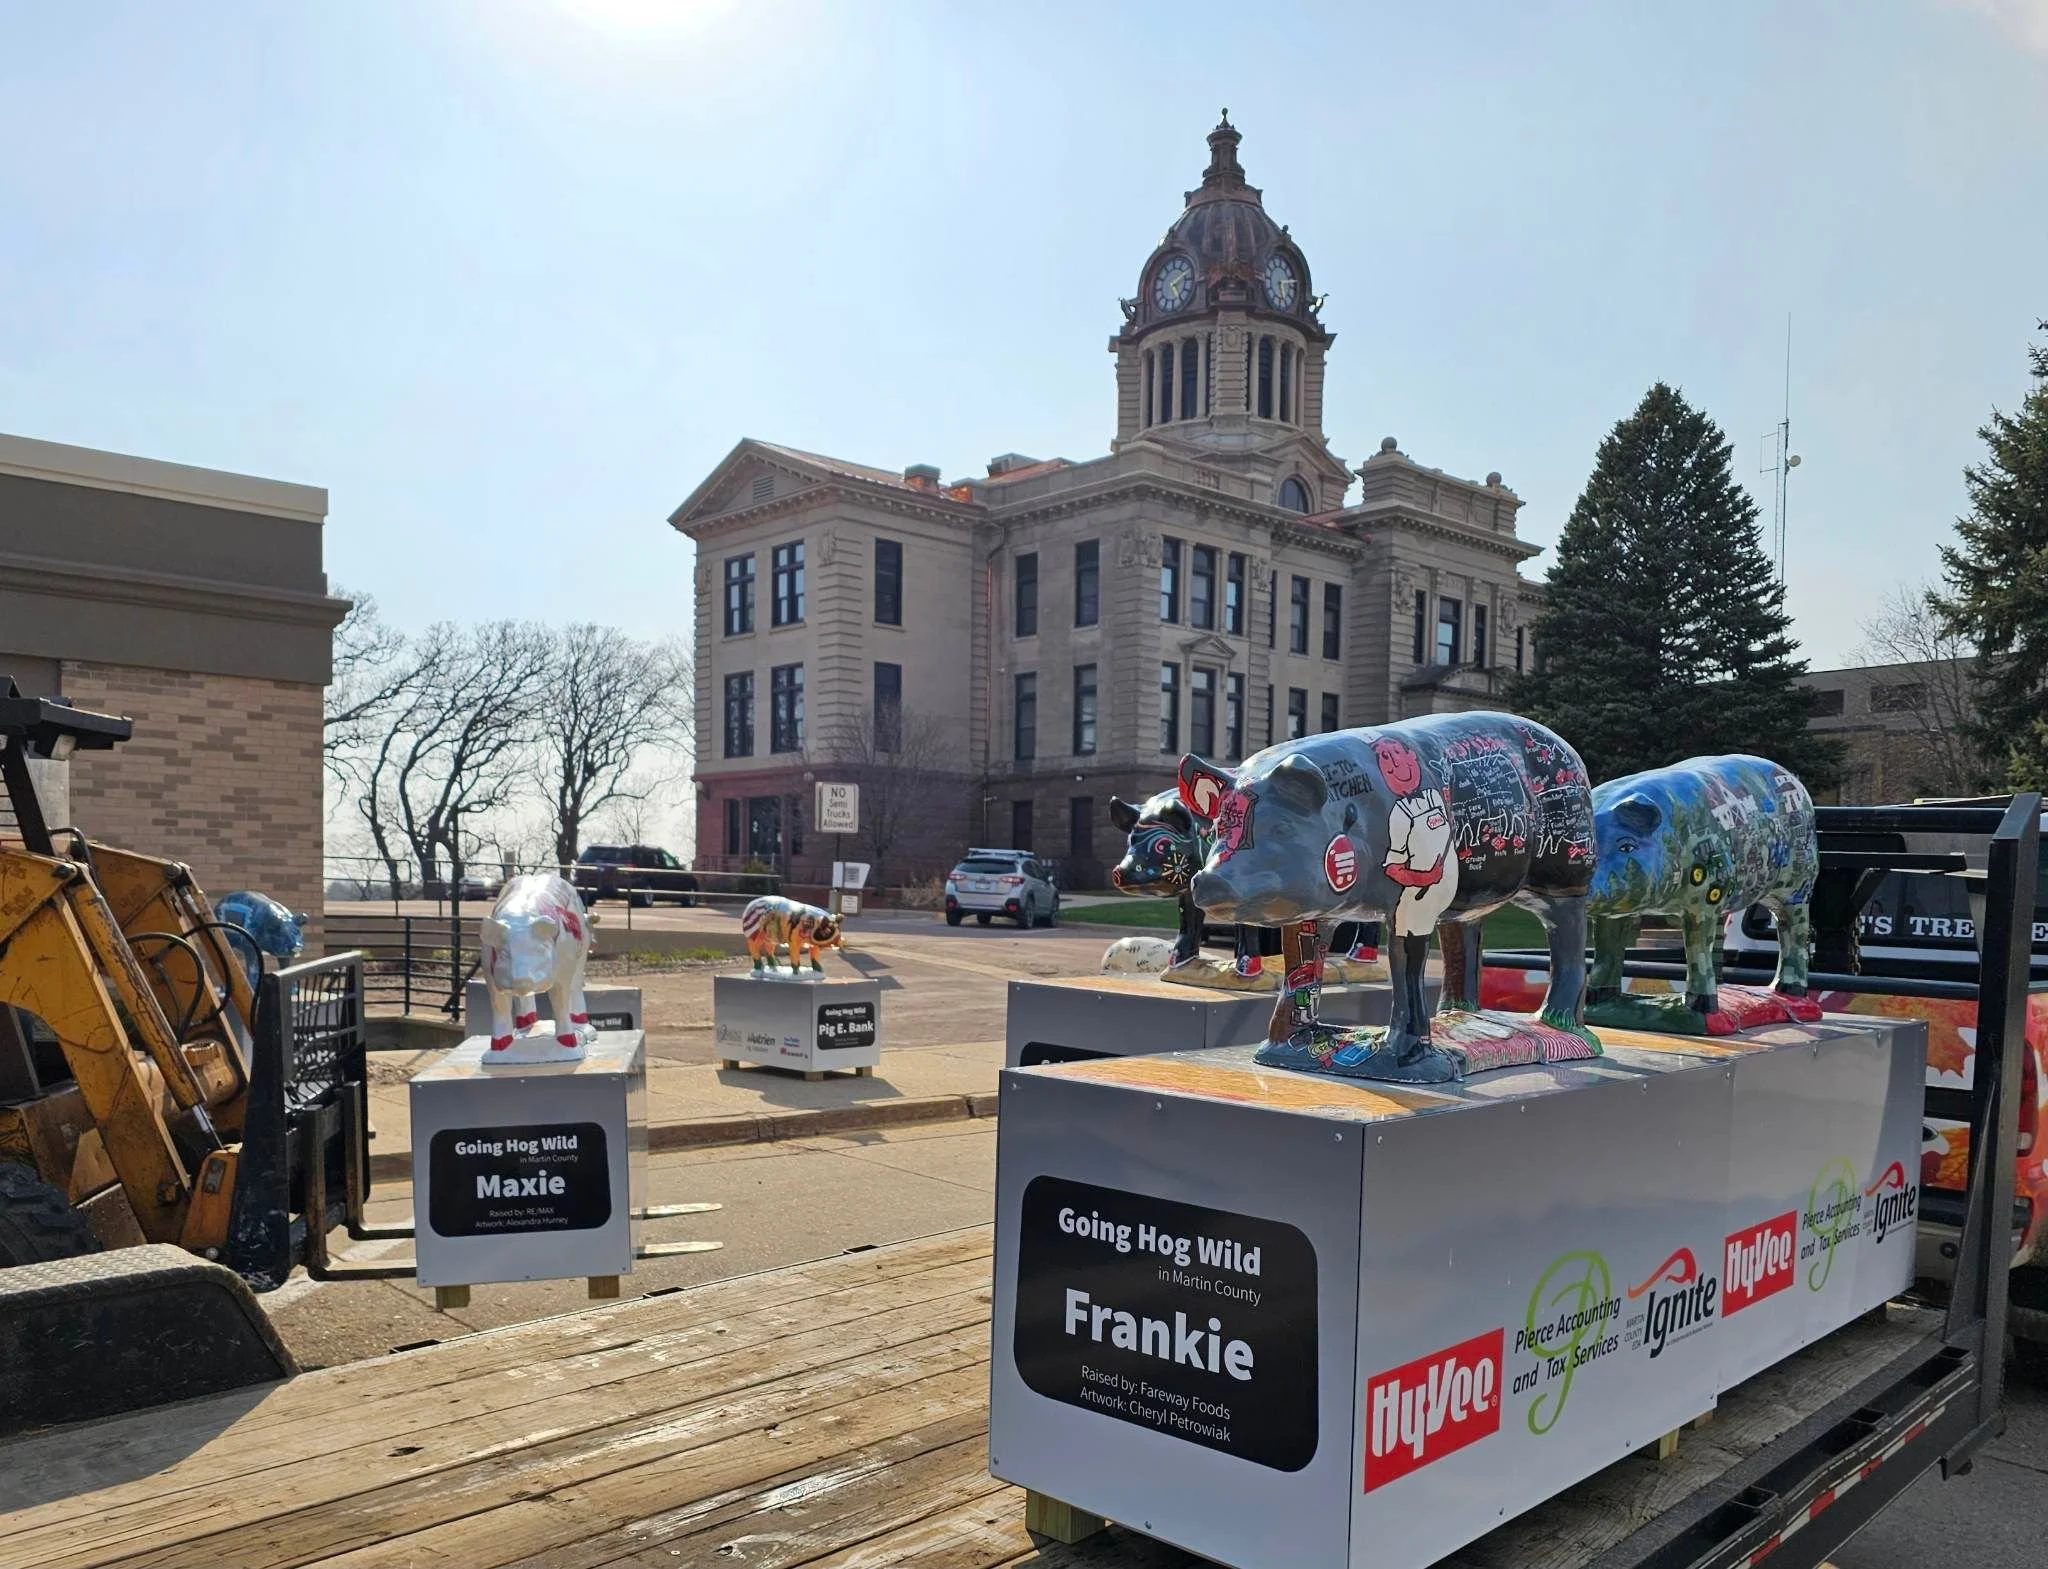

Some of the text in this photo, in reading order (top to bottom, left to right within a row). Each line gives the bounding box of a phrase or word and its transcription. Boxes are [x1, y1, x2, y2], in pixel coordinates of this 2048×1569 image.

[829, 799, 848, 808] Semi
[831, 787, 846, 798] NO
[824, 819, 854, 829] Allowed
[826, 809, 851, 818] Trucks
[819, 1020, 874, 1037] Pig E. Bank
[455, 1135, 578, 1156] Going Hog Wild
[520, 1153, 579, 1163] in Martin County
[476, 1169, 566, 1199] Maxie
[489, 1209, 513, 1217] Raised
[1802, 1209, 1825, 1231] Pierce
[1873, 1182, 1916, 1244] Ignite
[1058, 1207, 1261, 1277] Going Hog Wild
[1801, 1238, 1815, 1259] and
[1833, 1223, 1861, 1245] Services
[1158, 1266, 1261, 1307] in Martin County
[1514, 1296, 1622, 1354] Pierce Accounting
[1644, 1272, 1717, 1359] Ignite
[1064, 1287, 1255, 1382] Frankie
[1513, 1334, 1619, 1395] and Tax Services
[1081, 1365, 1231, 1420] Raised by: Fareway Foods
[1080, 1386, 1231, 1443] Artwork: Cheryl Petrowiak
